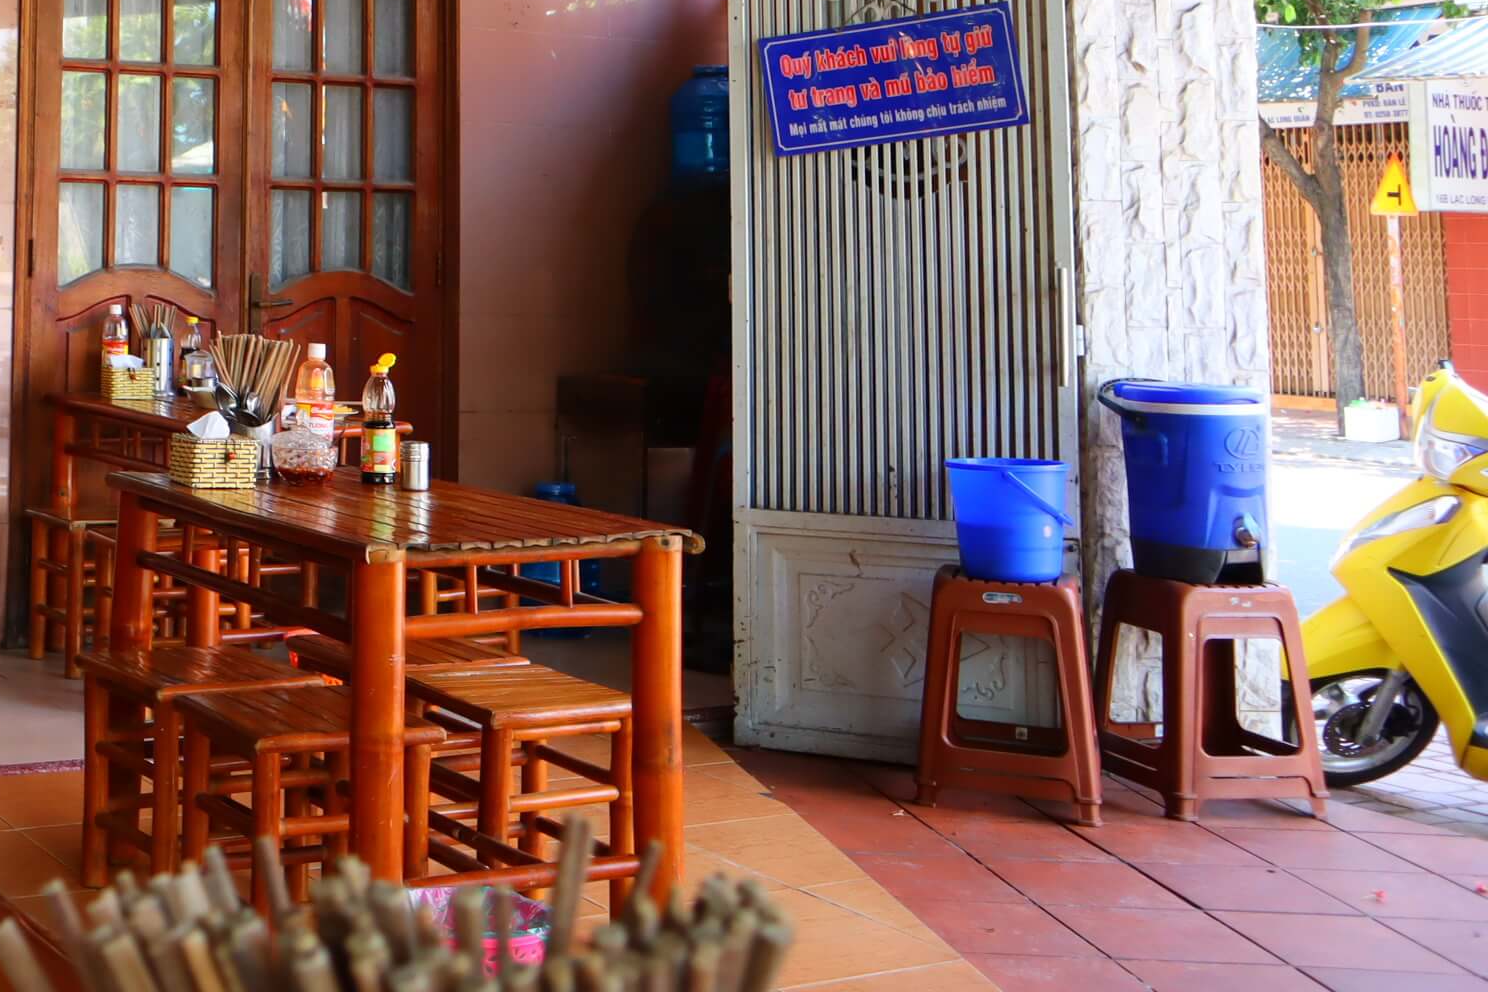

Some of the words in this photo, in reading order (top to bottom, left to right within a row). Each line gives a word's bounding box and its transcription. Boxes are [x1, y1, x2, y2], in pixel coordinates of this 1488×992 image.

[780, 51, 811, 79] Quý
[815, 44, 867, 72] khách
[870, 38, 896, 64] vui
[941, 31, 961, 57] tự
[964, 25, 992, 55] giữ
[788, 88, 808, 111] tư
[810, 85, 857, 108] trang
[859, 76, 882, 100] và
[884, 72, 912, 97] mũ
[914, 67, 948, 93] bảo
[951, 58, 995, 88] hiểm
[789, 123, 807, 138] Mọi
[830, 117, 848, 129] mát
[850, 111, 878, 128] chúng
[880, 110, 893, 124] tôi
[895, 107, 925, 122] không
[927, 104, 947, 119] chịu
[949, 100, 975, 114] trách
[977, 96, 1007, 112] nhiệm
[1433, 113, 1477, 179] HOÀNG
